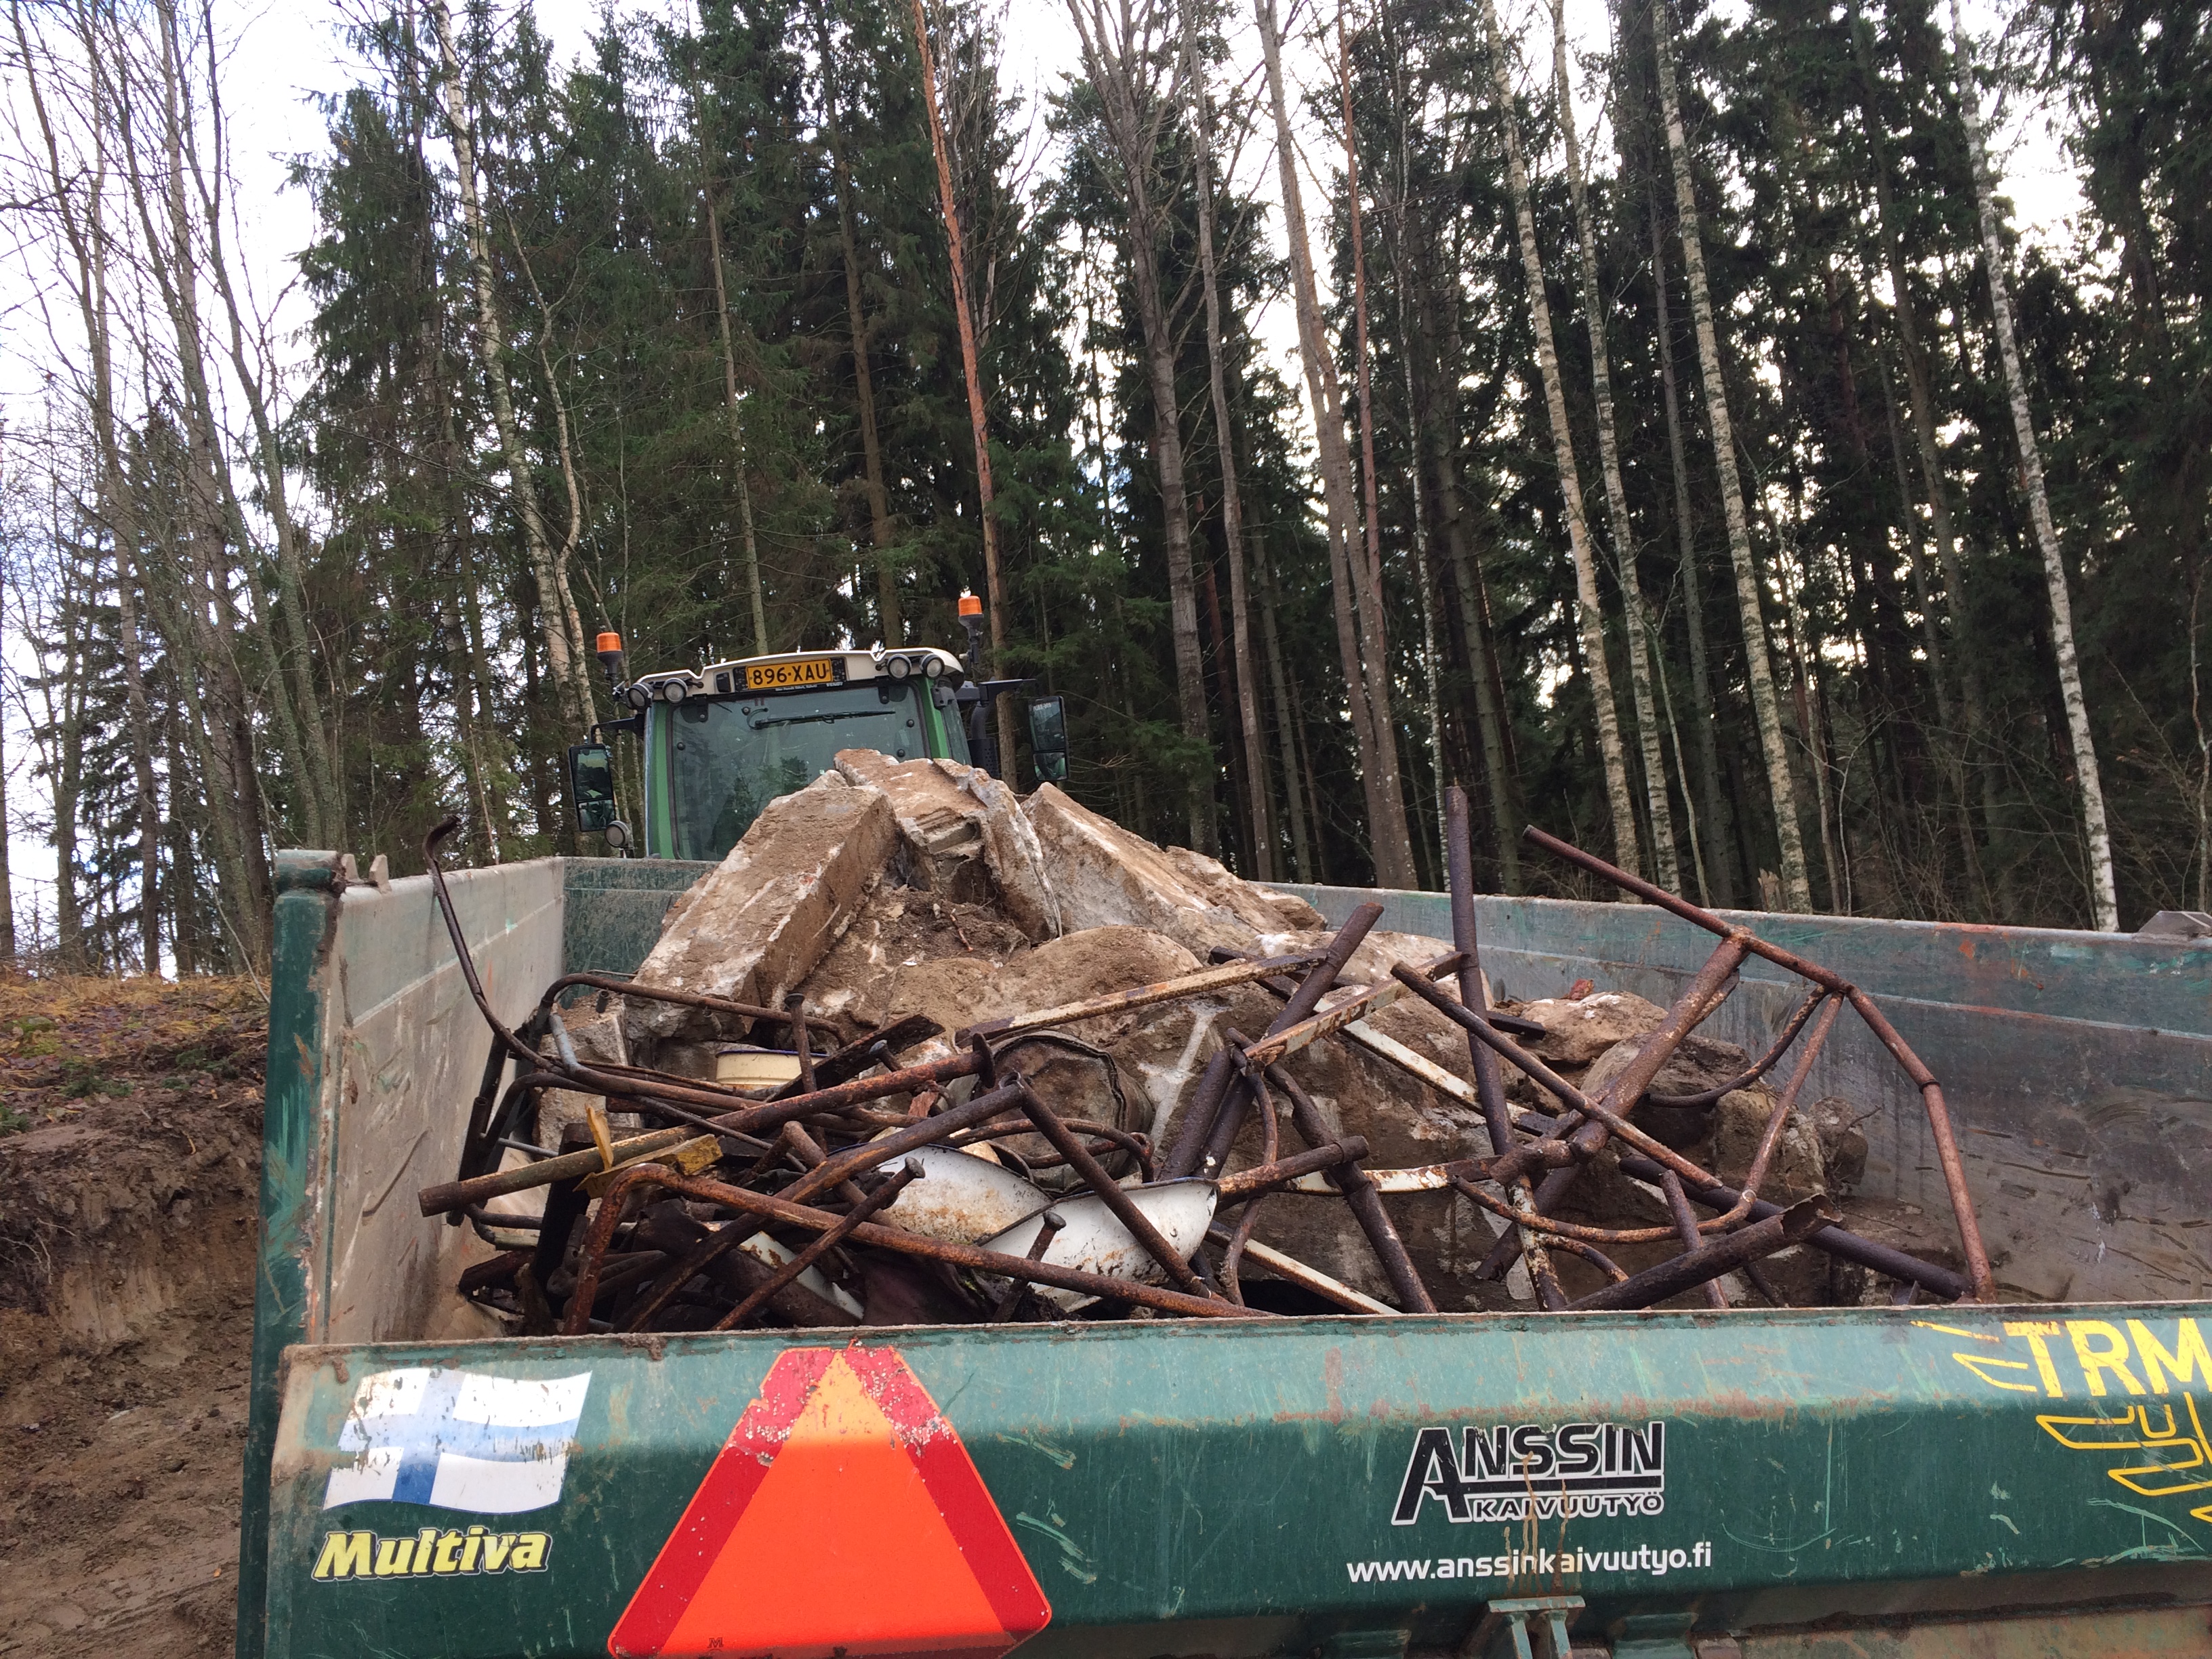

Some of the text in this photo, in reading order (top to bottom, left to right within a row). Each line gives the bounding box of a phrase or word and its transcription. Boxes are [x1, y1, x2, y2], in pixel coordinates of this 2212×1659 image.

[752, 663, 827, 685] 896-XAU
[2003, 1317, 2212, 1398] TRM
[1391, 1421, 1665, 1525] ANSSIN
[1473, 1490, 1664, 1522] KAIVUUTYÖ
[311, 1525, 553, 1582] Multiva
[1347, 1541, 1712, 1583] www.anssinkaivuutyo.fi
